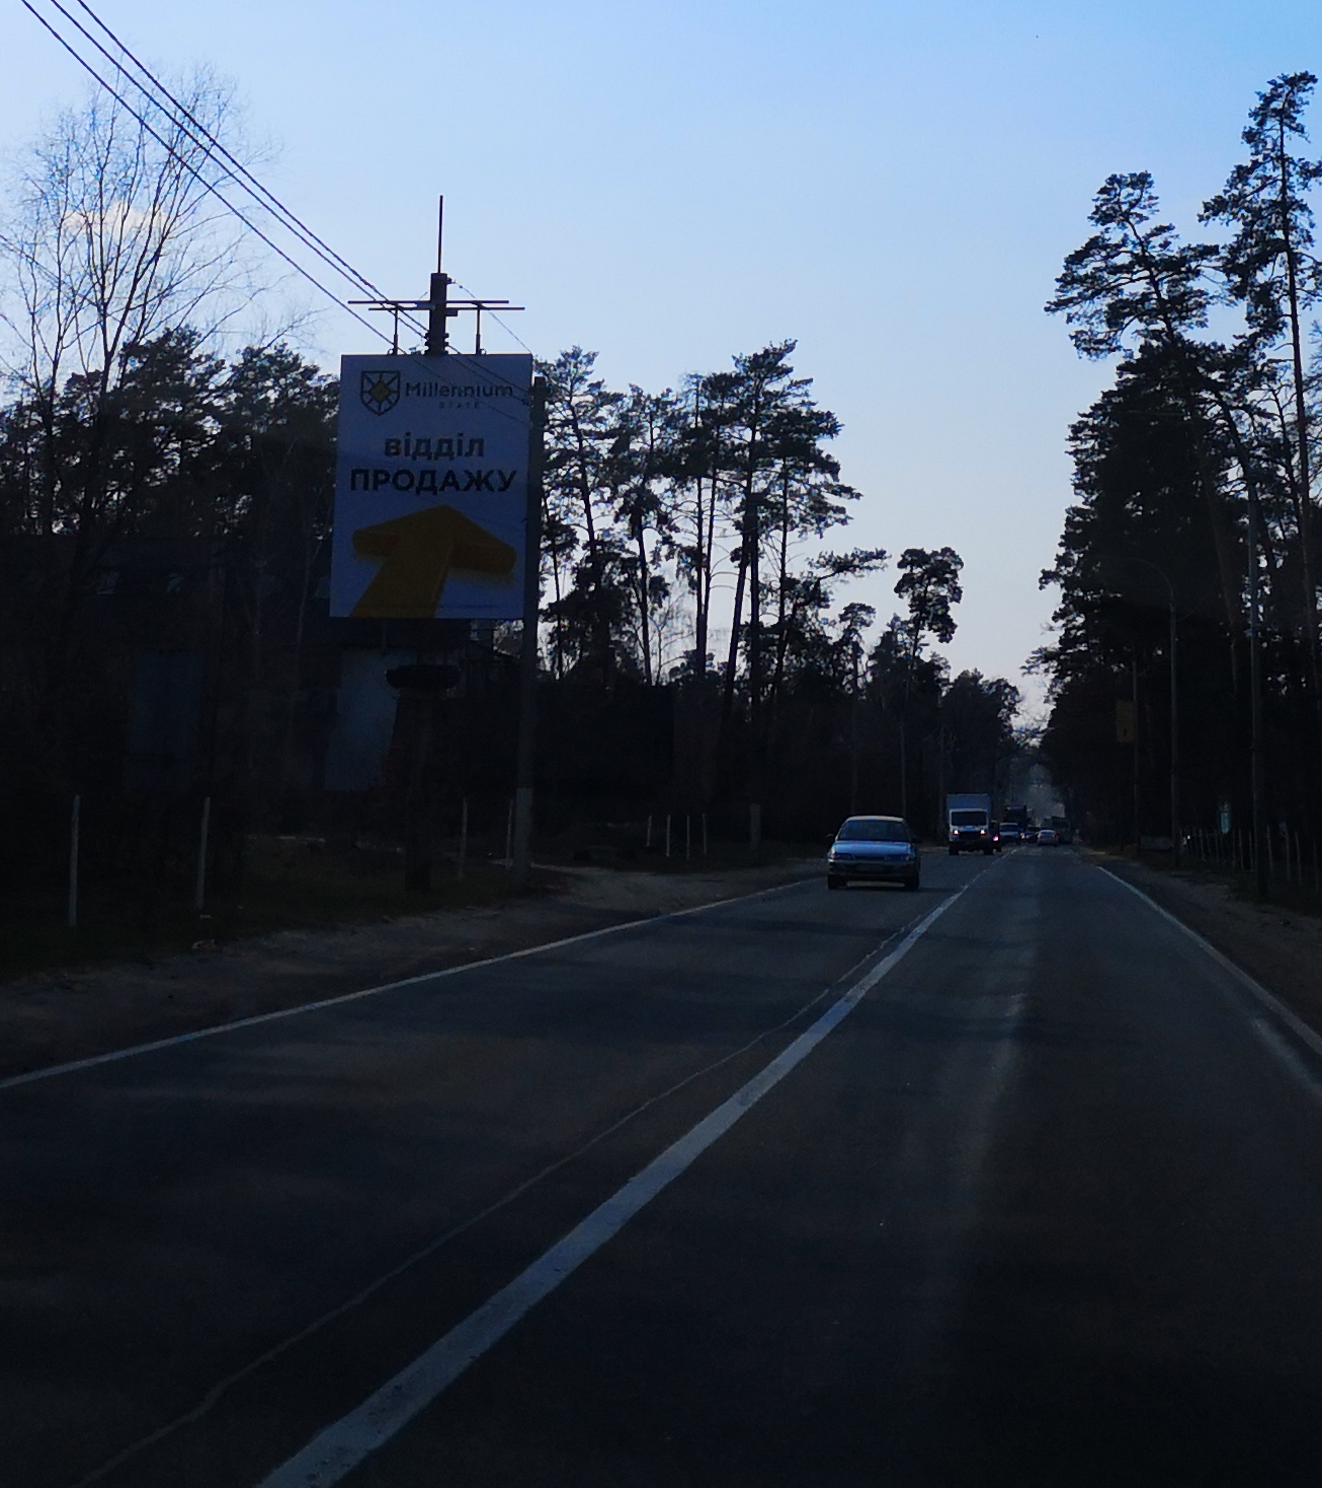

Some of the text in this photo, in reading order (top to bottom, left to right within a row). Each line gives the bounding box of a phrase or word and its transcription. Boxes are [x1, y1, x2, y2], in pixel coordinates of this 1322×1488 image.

[405, 382, 513, 398] Millennium
[385, 432, 485, 461] відділ
[351, 469, 516, 496] ПРОДАЖУ
